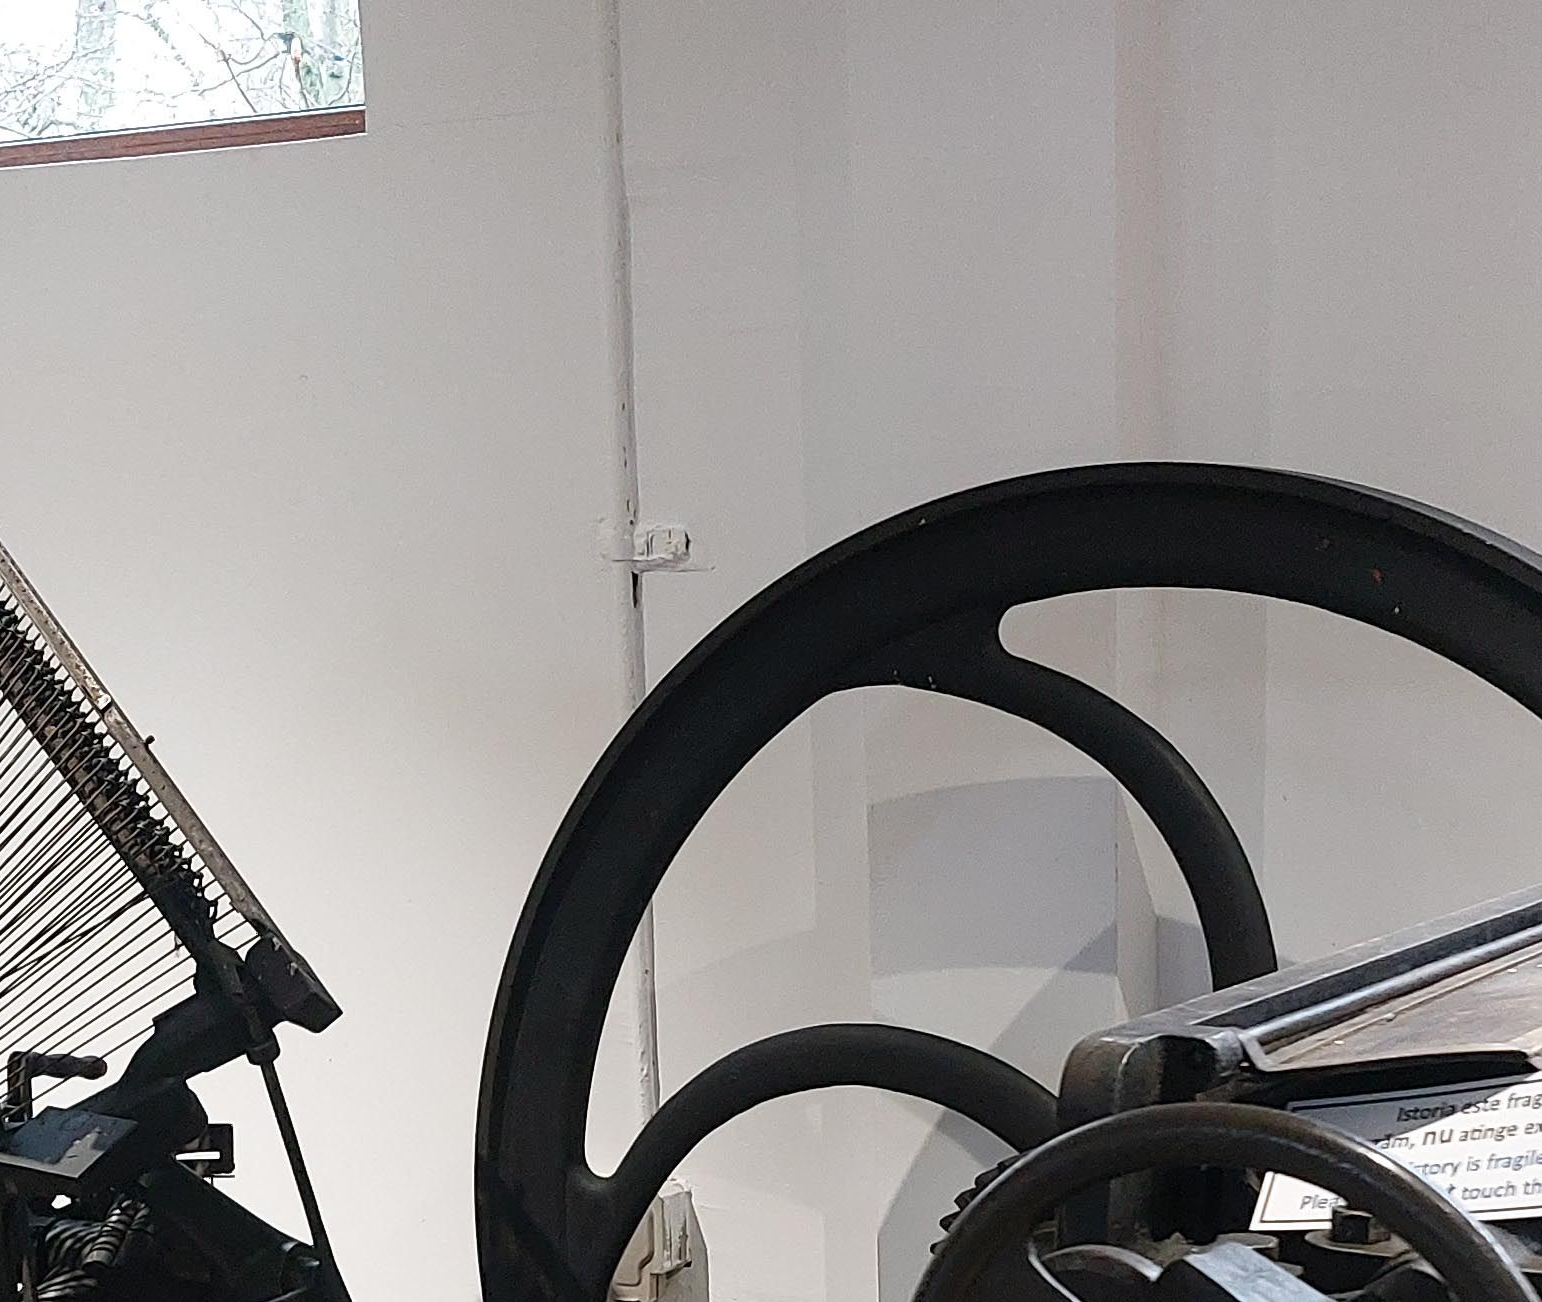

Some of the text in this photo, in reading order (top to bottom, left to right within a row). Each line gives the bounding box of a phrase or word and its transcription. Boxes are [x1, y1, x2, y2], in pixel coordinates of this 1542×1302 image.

[1396, 1100, 1456, 1122] Istoria
[1461, 1097, 1500, 1115] este
[1373, 1133, 1416, 1150] ăm,
[1422, 1128, 1454, 1146] nu
[1459, 1124, 1519, 1143] atinge
[1409, 1160, 1460, 1178] tory
[1466, 1156, 1481, 1172] is
[1299, 1194, 1340, 1210] Plea
[1462, 1181, 1516, 1201] touch
